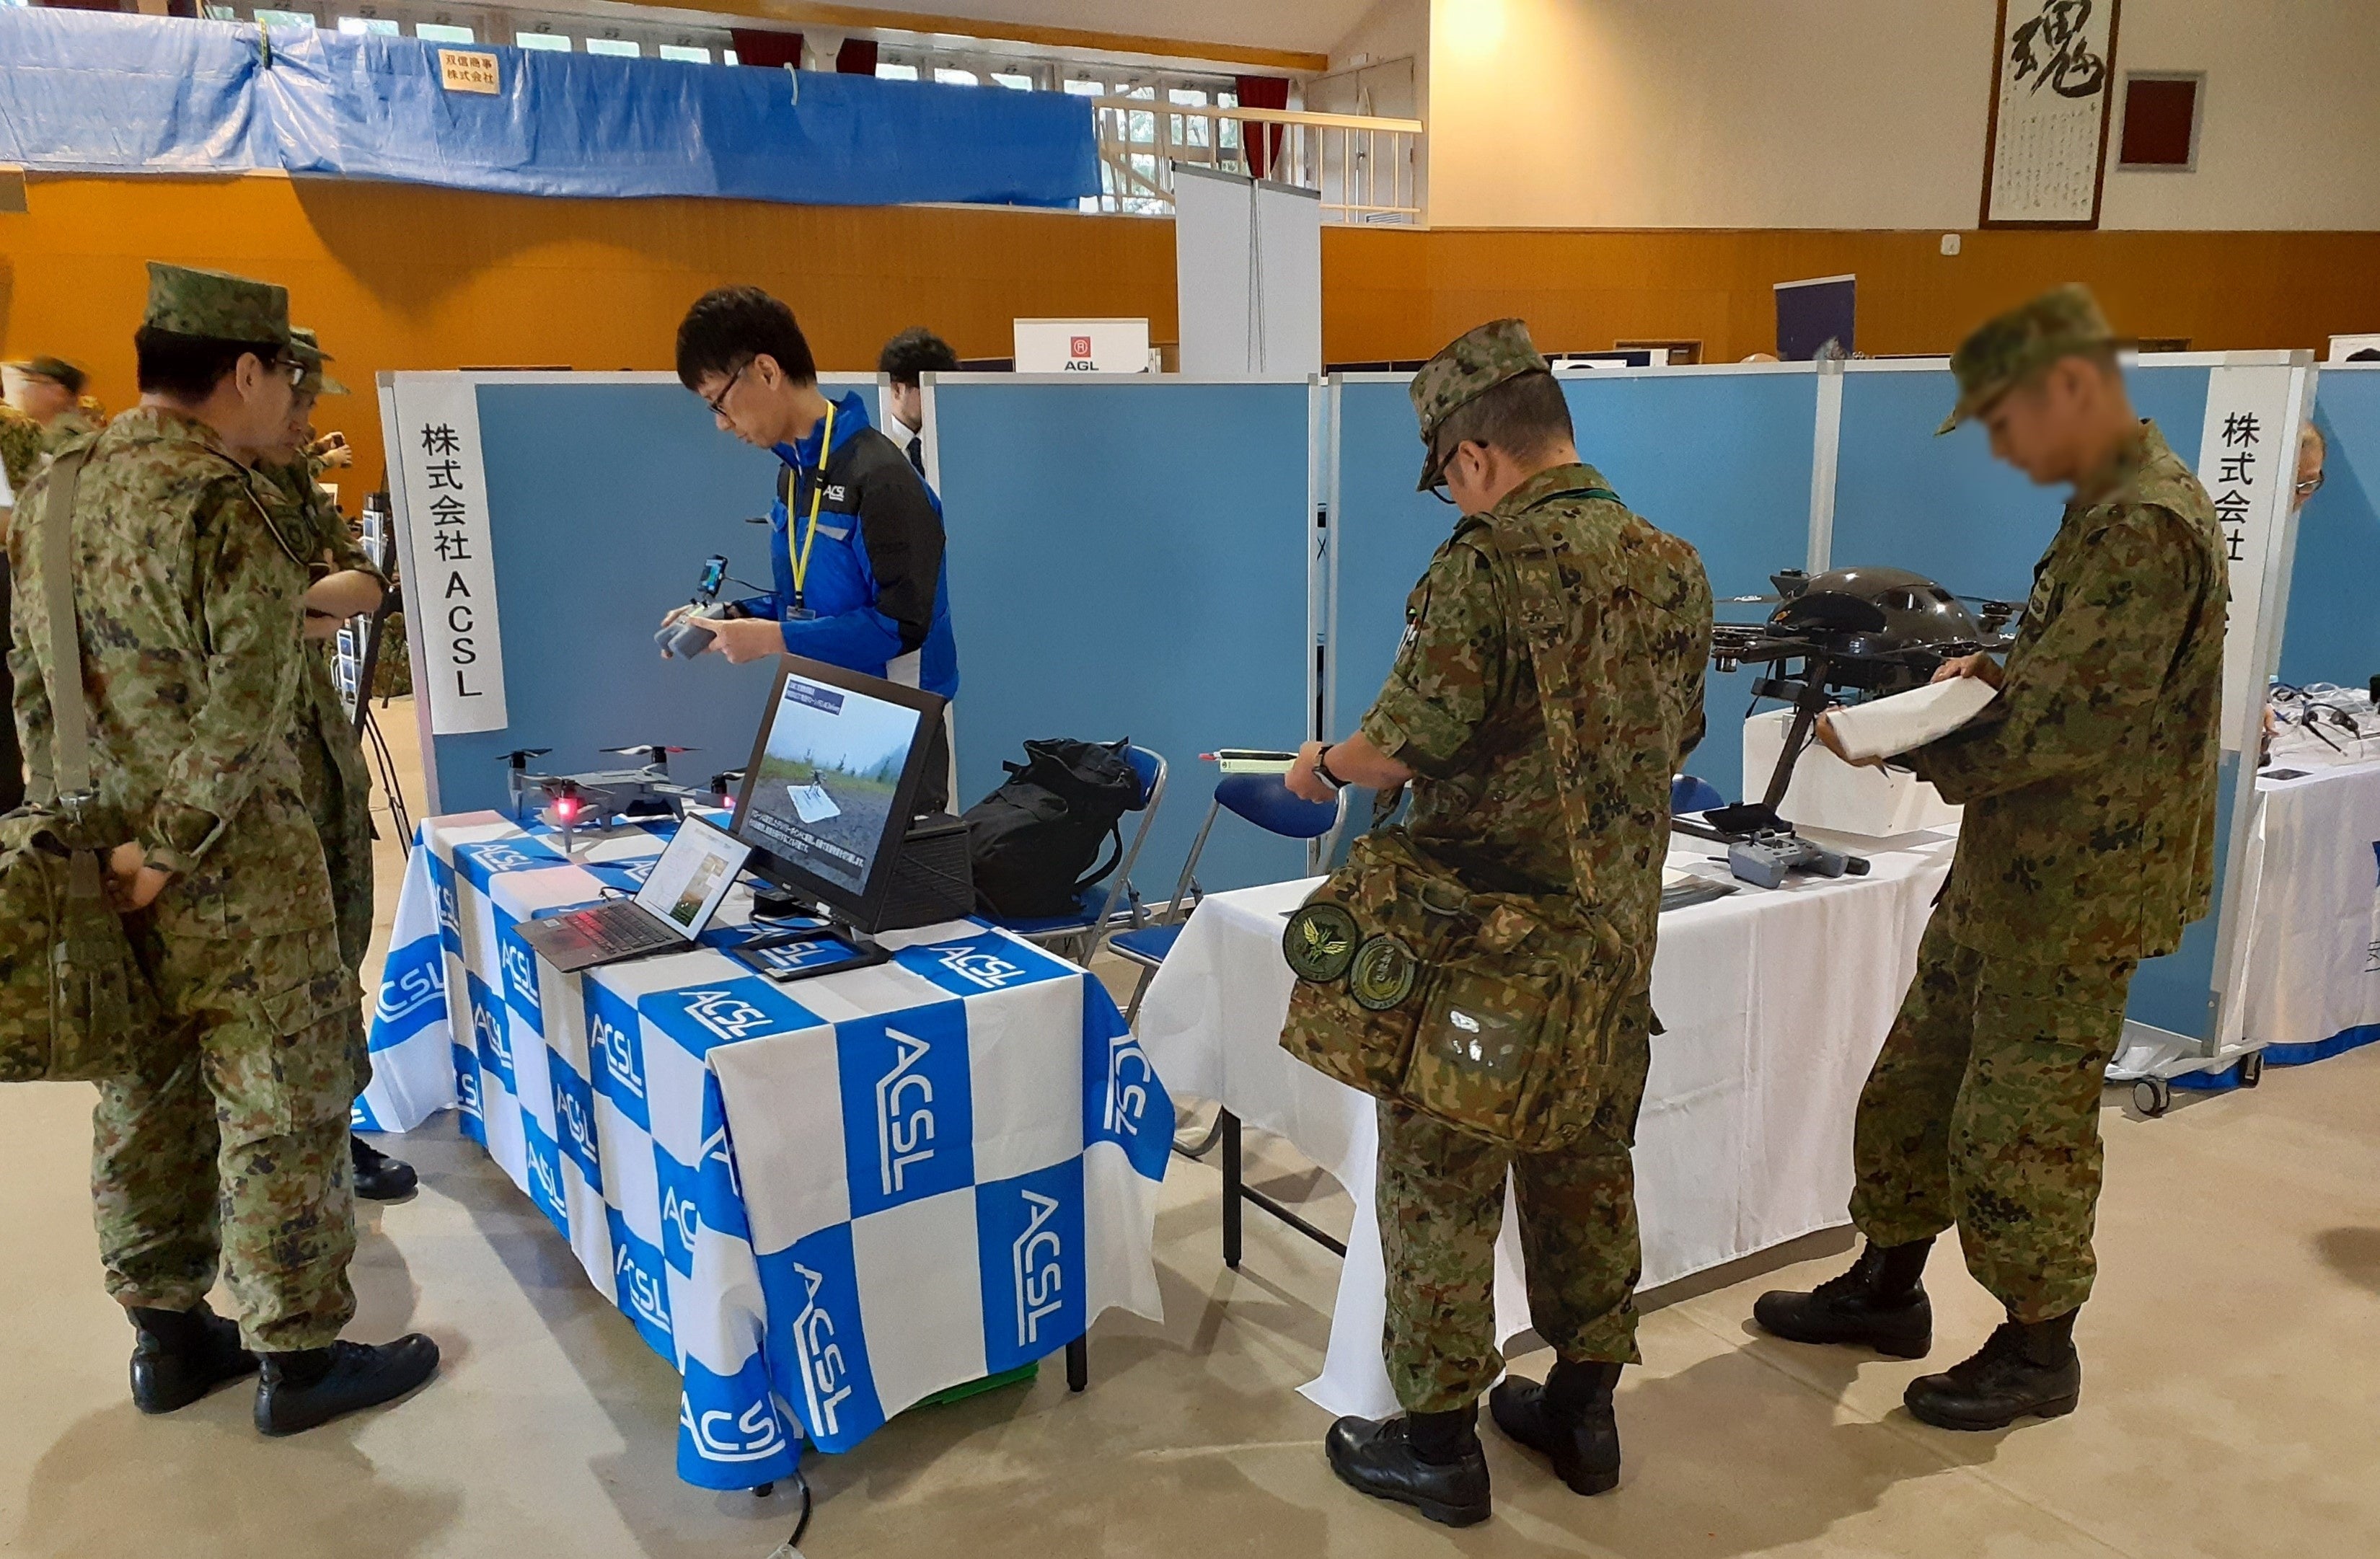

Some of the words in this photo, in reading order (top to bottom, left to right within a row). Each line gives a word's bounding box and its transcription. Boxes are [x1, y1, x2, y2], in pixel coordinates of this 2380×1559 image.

[447, 69, 493, 84] 株式会社
[1065, 361, 1099, 371] AGL
[823, 485, 845, 502] ACSL
[470, 844, 533, 873] ACSL
[374, 961, 445, 1023] CSL
[503, 938, 540, 1009] ACSL
[928, 946, 1026, 989] ACSL
[679, 991, 774, 1041] ACSL
[591, 1014, 644, 1099] ACSL
[557, 1083, 598, 1164] ACSL
[876, 1027, 935, 1196] ACSL
[1013, 1189, 1062, 1347] ACSL
[793, 1262, 852, 1437] ACSL
